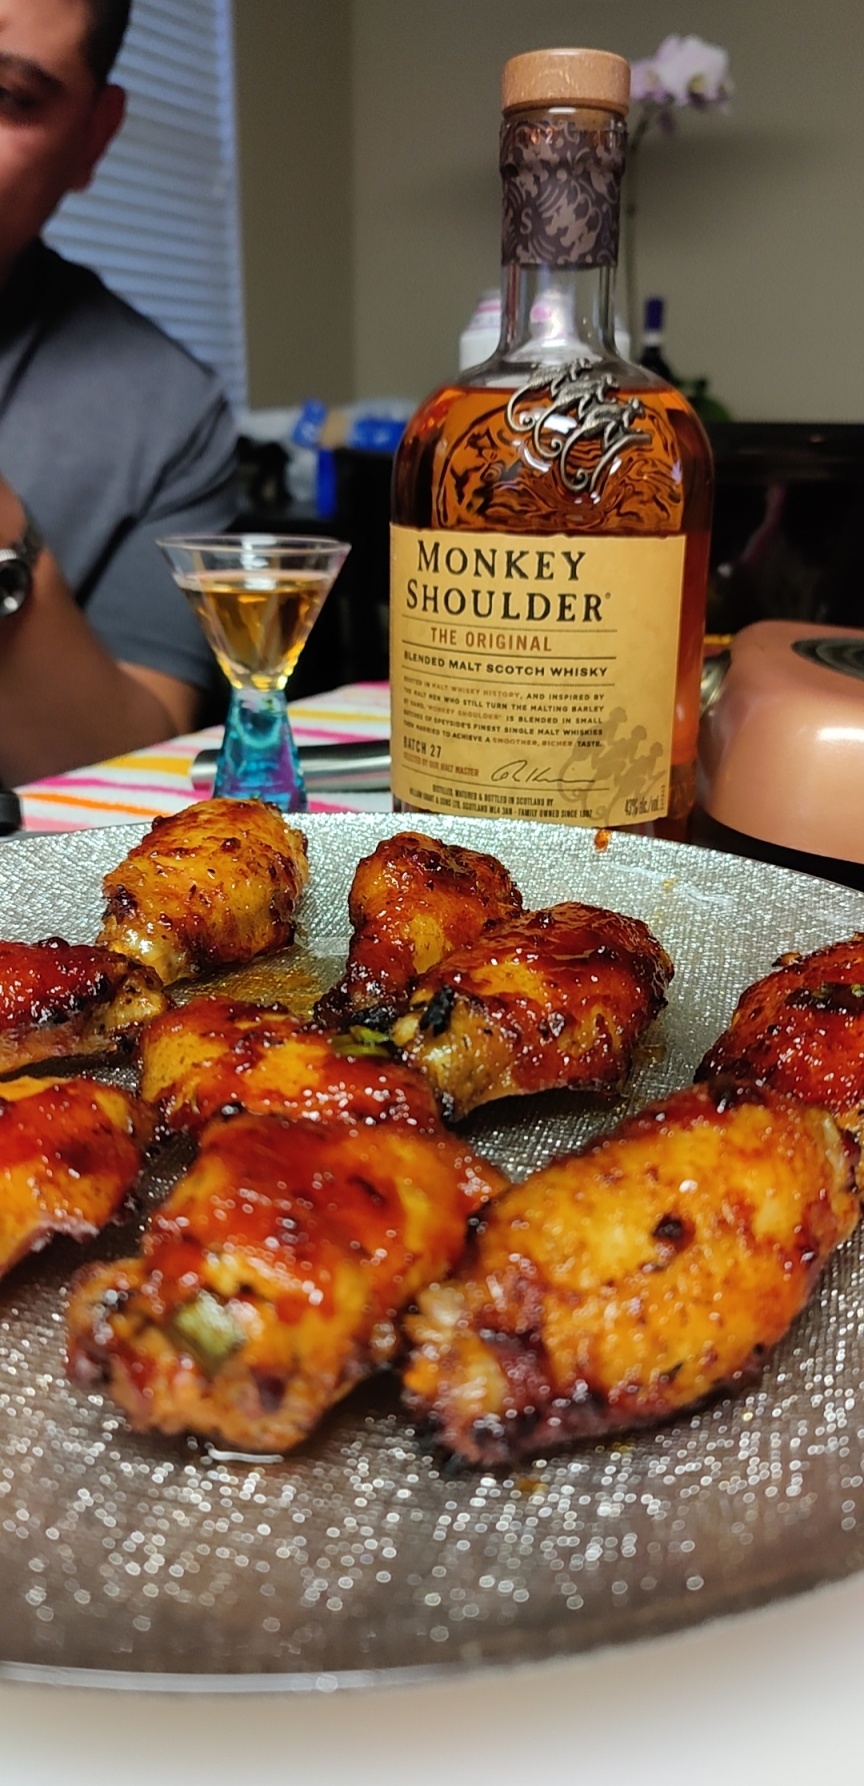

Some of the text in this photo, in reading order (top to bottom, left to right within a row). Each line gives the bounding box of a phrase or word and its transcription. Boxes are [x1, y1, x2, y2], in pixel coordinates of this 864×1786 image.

[417, 539, 586, 582] MONKEY
[430, 627, 553, 652] THE ORIGINAL
[404, 650, 608, 678] BLENDED MALT SCOTCH WHISKY
[432, 682, 448, 690] MALT
[451, 686, 480, 695] WHISKY
[463, 700, 483, 708] STILL
[486, 702, 508, 710] TURN
[474, 724, 501, 732] FINEST
[504, 727, 534, 735] SINGLE
[452, 733, 482, 742] ACHIEVE
[404, 736, 442, 758] BATCH 27
[455, 766, 479, 777] MASTER
[484, 794, 507, 804] BOTTLED
[516, 797, 545, 806] SCOTLAND
[546, 798, 554, 806] BY
[462, 802, 487, 813] SCOTLAND
[518, 808, 538, 817] FAMILY
[540, 809, 559, 818] OWNED
[561, 810, 577, 818] SINCE
